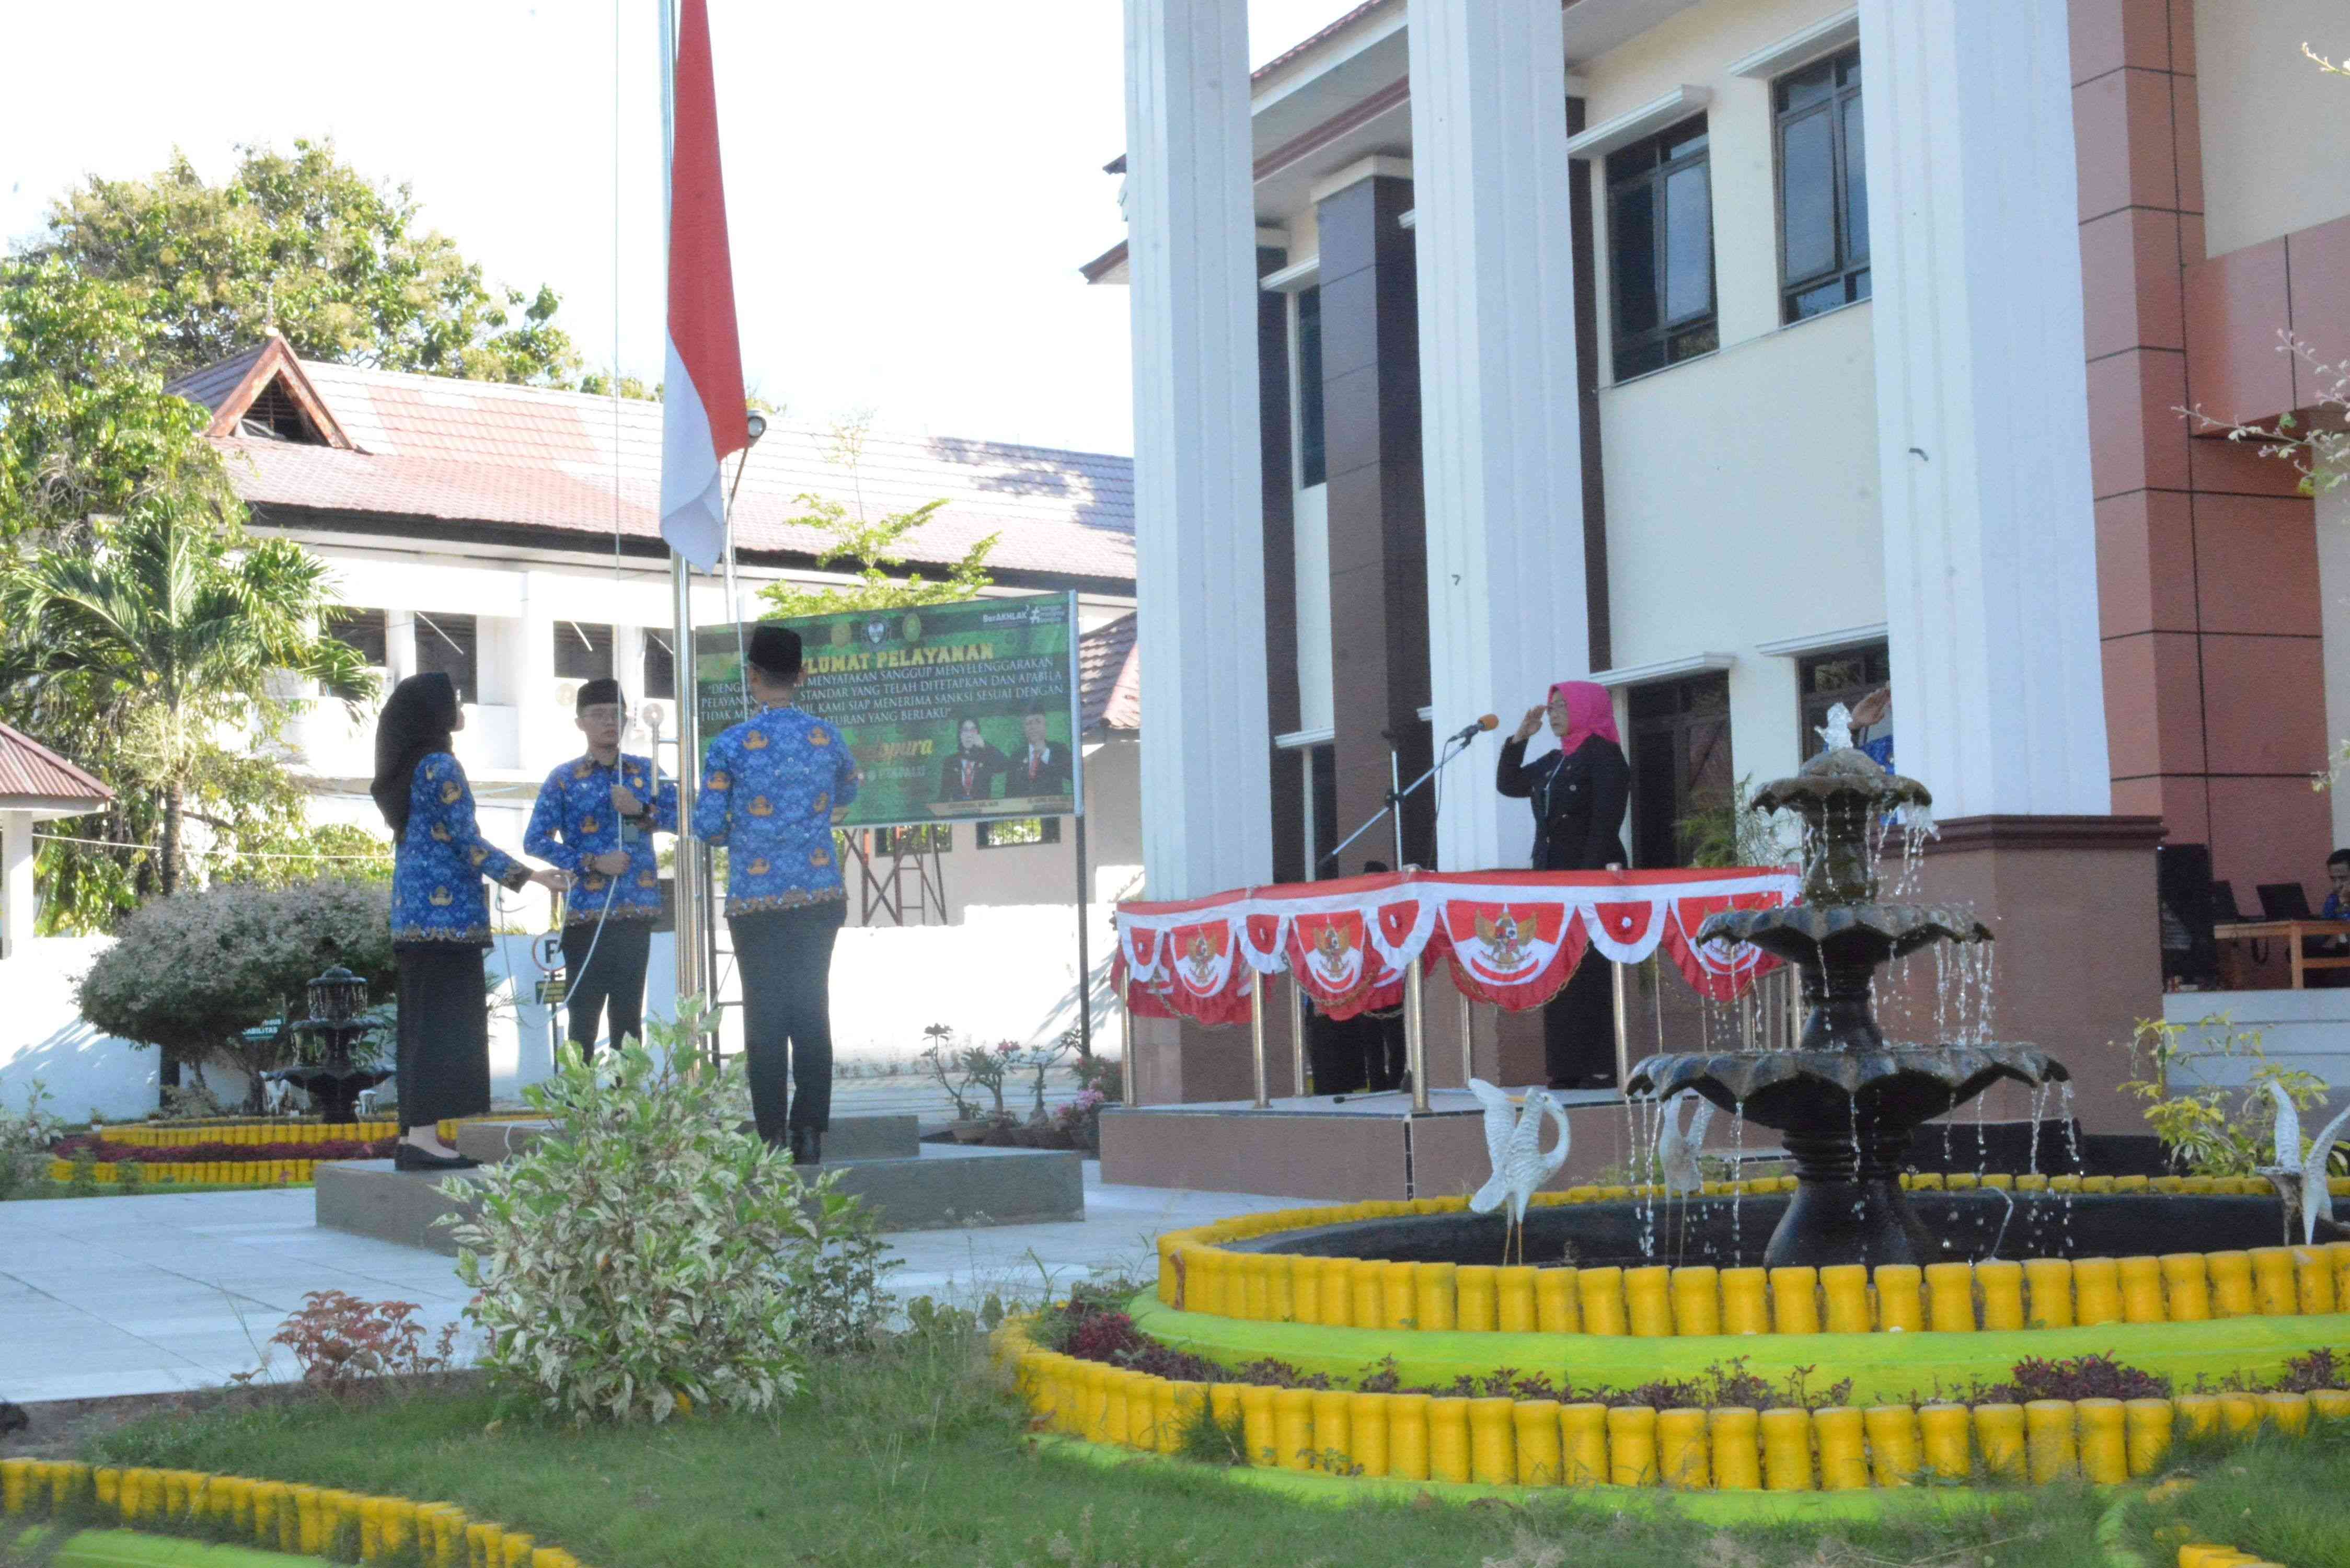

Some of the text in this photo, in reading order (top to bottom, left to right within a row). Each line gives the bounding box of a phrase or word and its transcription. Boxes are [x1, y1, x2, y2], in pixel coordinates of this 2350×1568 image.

[983, 611, 1027, 623] BerAKHLAK
[801, 643, 994, 675] LUMAT PELAYANAN
[808, 671, 877, 686] MENYATAKAN
[880, 667, 932, 680] SANGGUP
[935, 657, 1054, 677] MENYELENGGARAKAN
[800, 687, 849, 701] STANDAR
[851, 685, 880, 697] YANG
[884, 681, 916, 695] TELAH
[920, 675, 987, 692] DITETAPKAN
[990, 673, 1016, 687] DAN
[1019, 671, 1062, 684] APABILA
[700, 710, 732, 722] TIDAK
[819, 701, 845, 713] KAMI
[848, 699, 871, 711] SIAP
[873, 696, 931, 709] MENERIMA
[935, 691, 973, 704] SANKSI
[977, 688, 1012, 701] SESUAI
[1016, 685, 1064, 698] DENGAN
[869, 711, 897, 723] YANG
